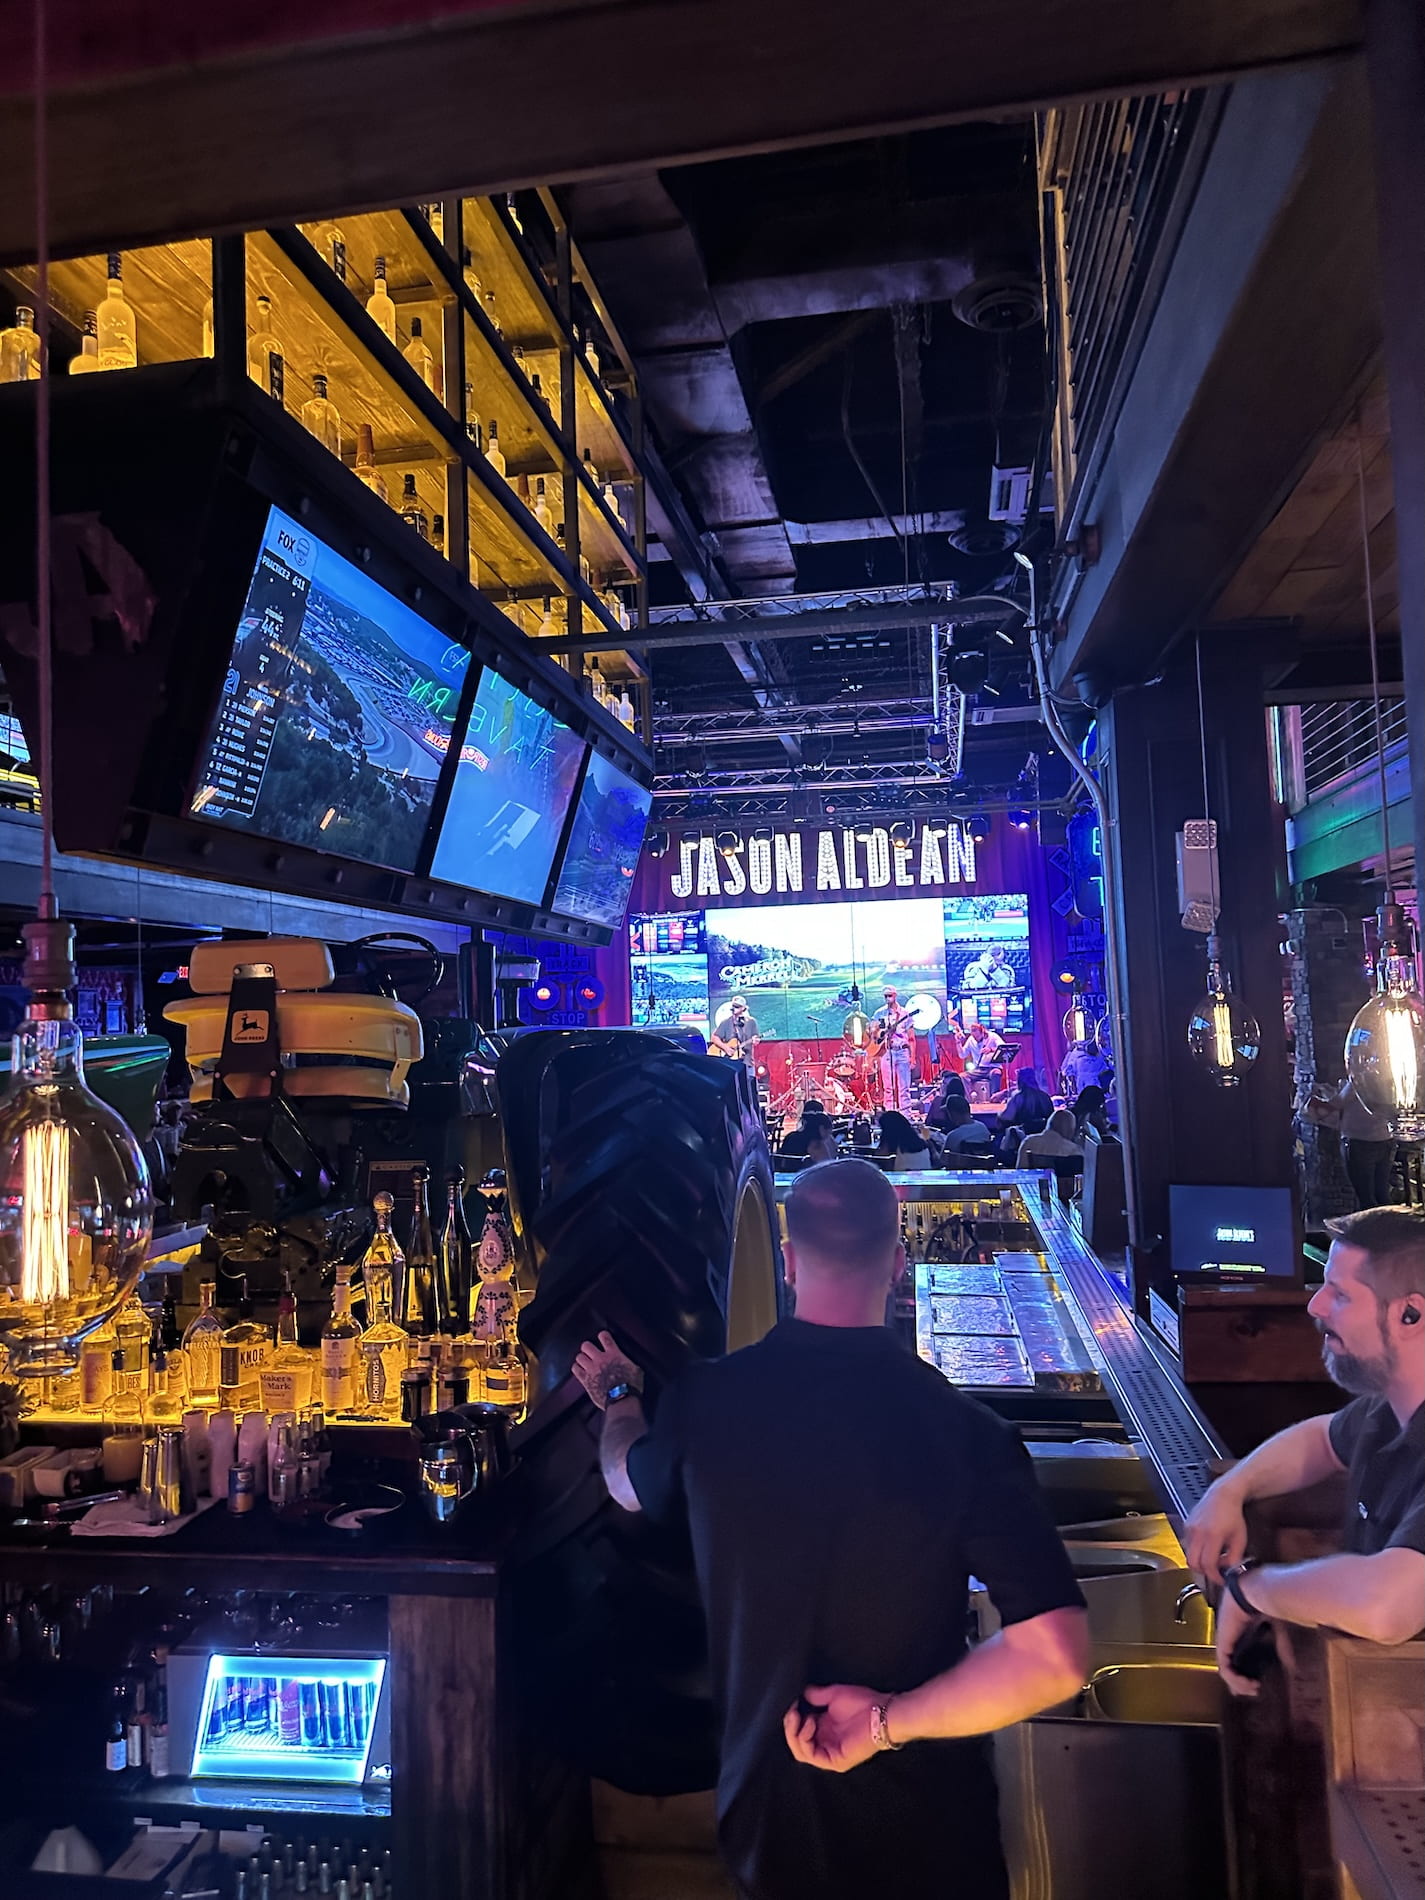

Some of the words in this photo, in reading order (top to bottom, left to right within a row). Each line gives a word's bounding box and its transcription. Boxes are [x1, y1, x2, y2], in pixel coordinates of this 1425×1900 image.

[277, 529, 296, 553] FOX
[245, 687, 276, 708] JOHNSON
[671, 832, 803, 898] JASON
[816, 823, 977, 891] ALDEAN
[719, 956, 792, 983] CAMERON
[552, 1013, 585, 1024] STOP
[240, 1348, 265, 1365] KNOB
[268, 1382, 291, 1390] Mark
[372, 1359, 380, 1402] HORNITOS
